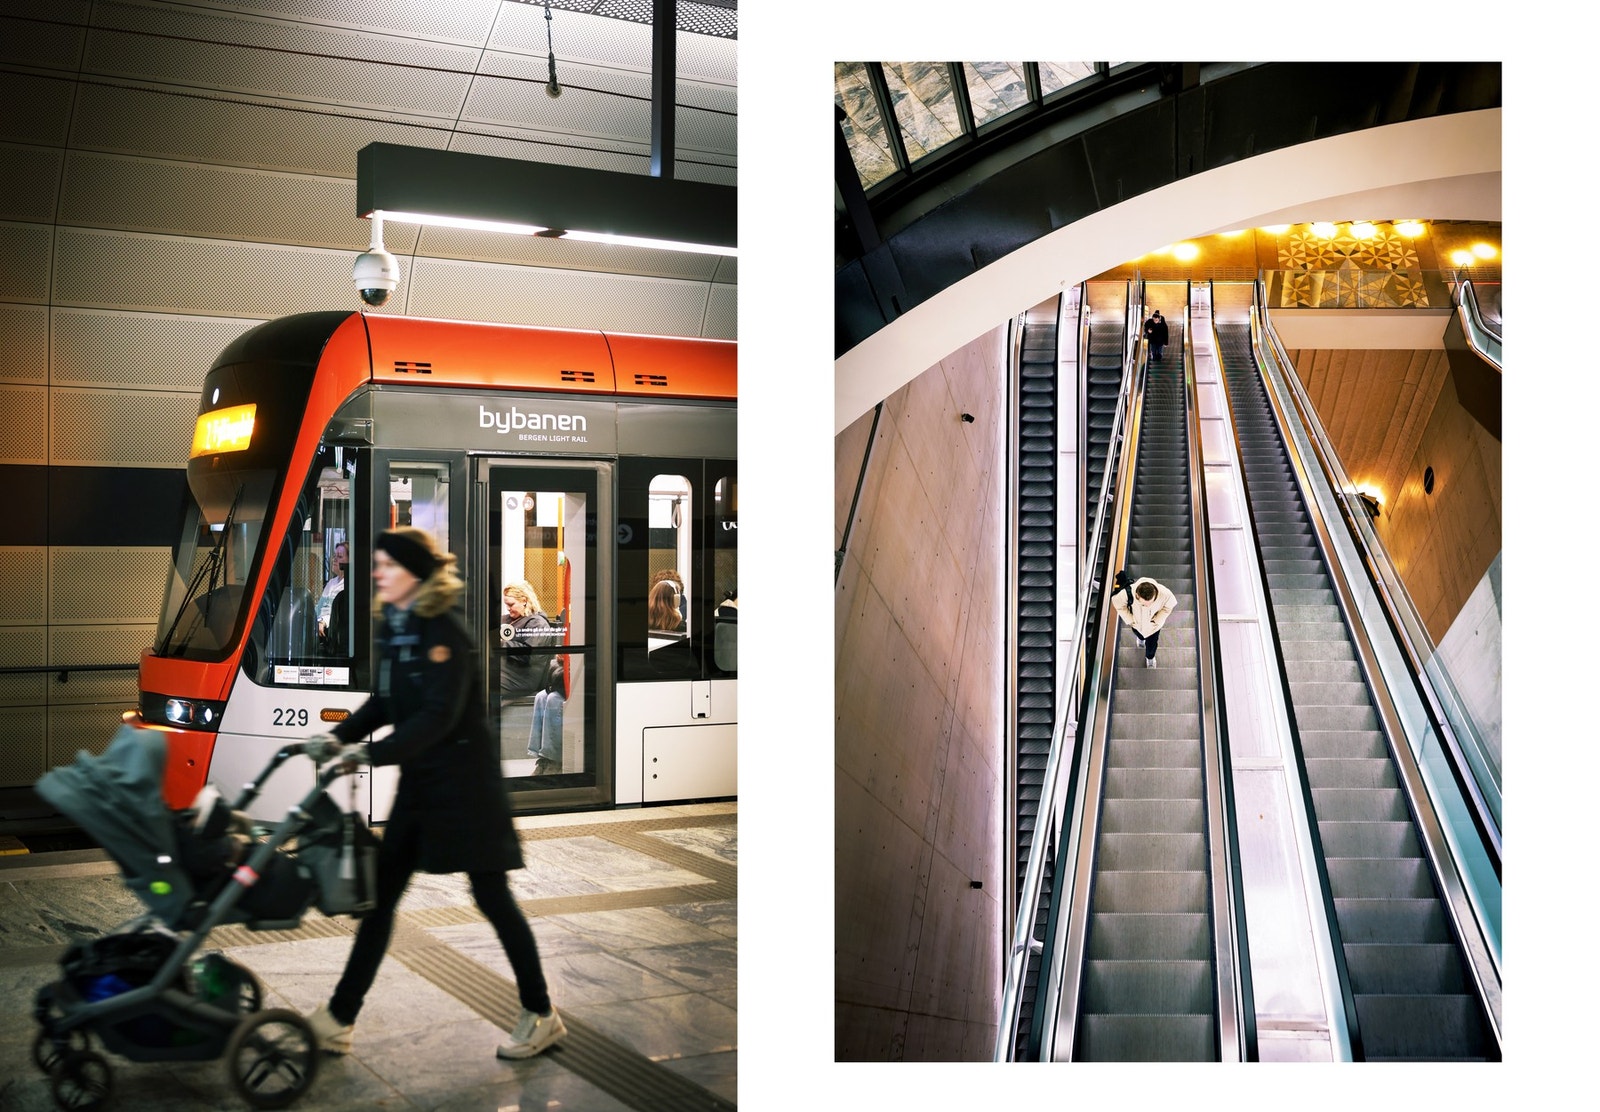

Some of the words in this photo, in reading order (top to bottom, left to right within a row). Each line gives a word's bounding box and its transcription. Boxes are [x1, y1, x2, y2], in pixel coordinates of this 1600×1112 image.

[479, 405, 587, 434] bybanen
[518, 434, 548, 442] BERGEN
[549, 435, 570, 443] LIGHT
[273, 708, 308, 727] 229
